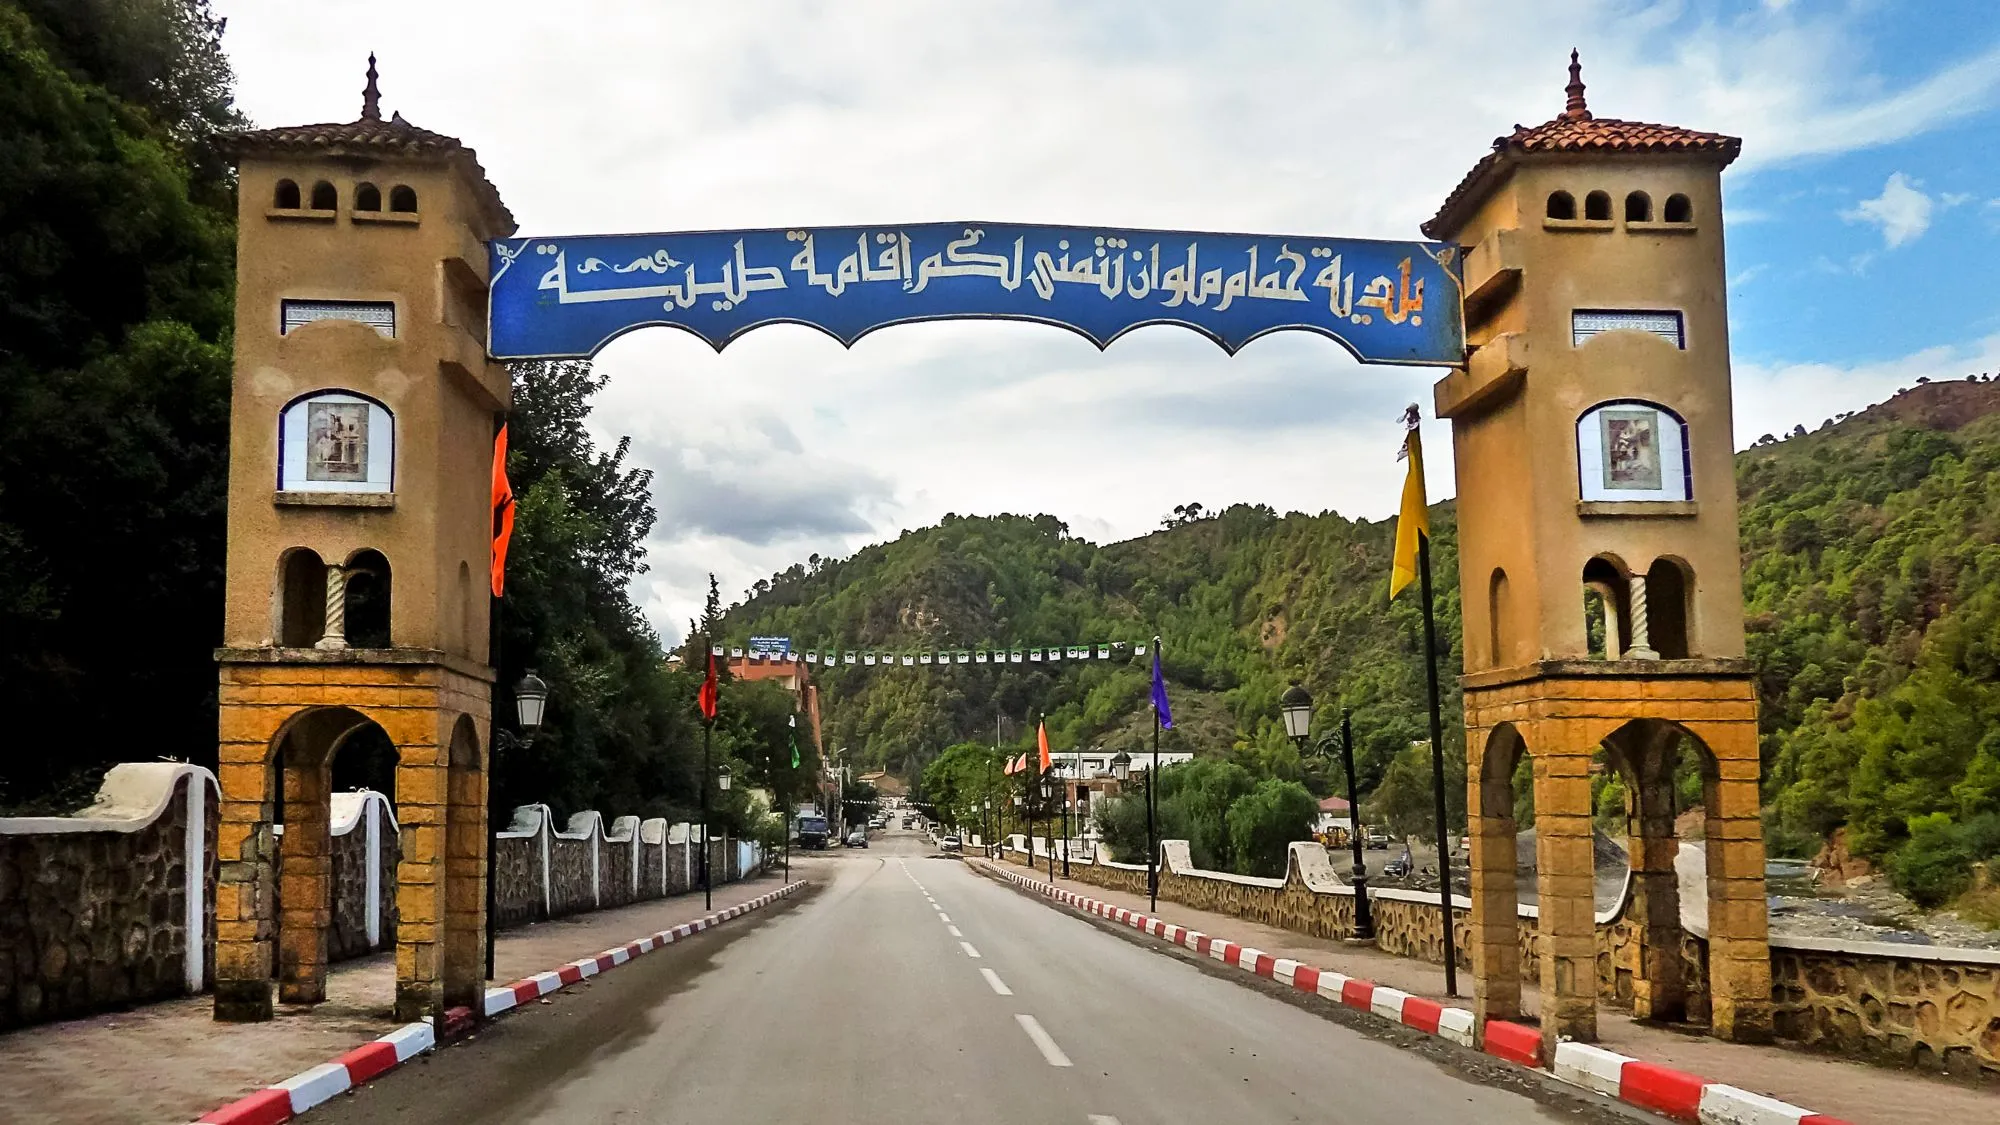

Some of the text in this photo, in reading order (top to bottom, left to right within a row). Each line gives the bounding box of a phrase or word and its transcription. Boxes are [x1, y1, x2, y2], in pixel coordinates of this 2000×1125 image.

[536, 237, 789, 312] طيبة
[906, 228, 1024, 293] لكم
[1126, 242, 1222, 307] ملوان
[1211, 243, 1310, 311] حمام
[1311, 247, 1424, 327] بلدية
